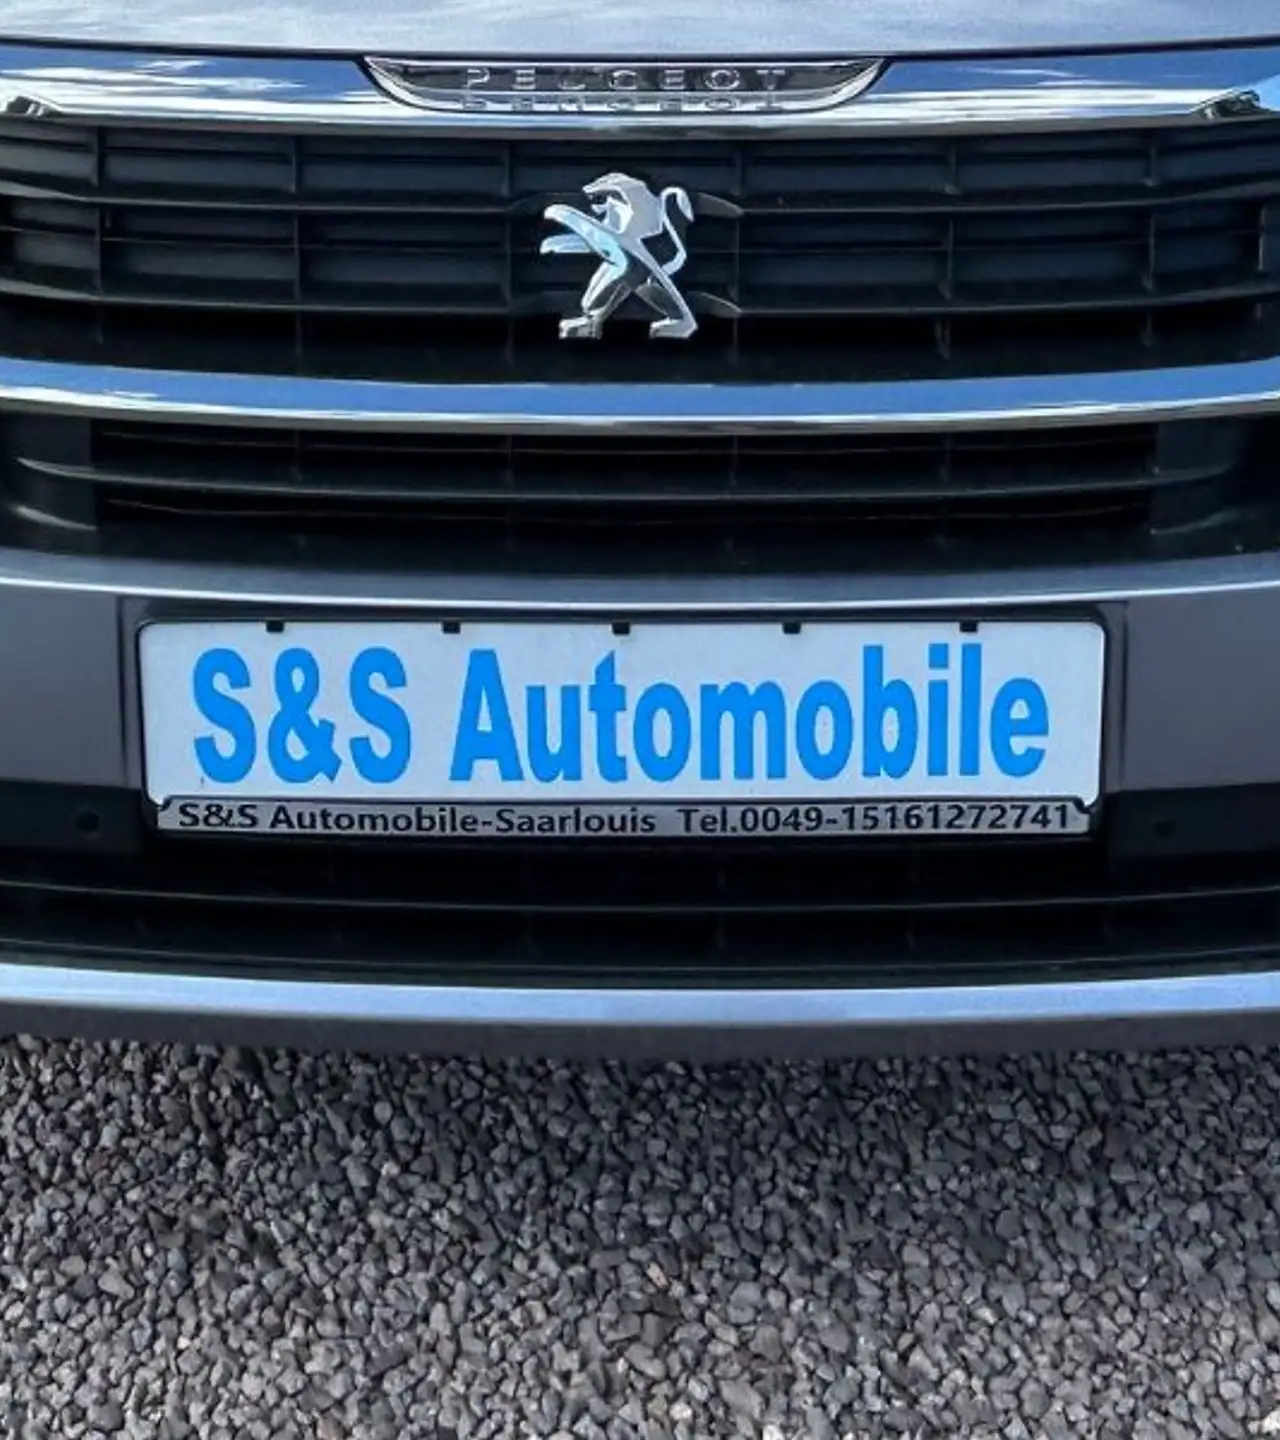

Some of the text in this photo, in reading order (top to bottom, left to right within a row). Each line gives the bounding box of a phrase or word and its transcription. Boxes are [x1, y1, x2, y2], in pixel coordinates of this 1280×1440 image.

[192, 642, 1051, 785] S&S Automobile
[177, 802, 1070, 834] S&S Automobile-Saarlouis Tel.0049-15161272741
